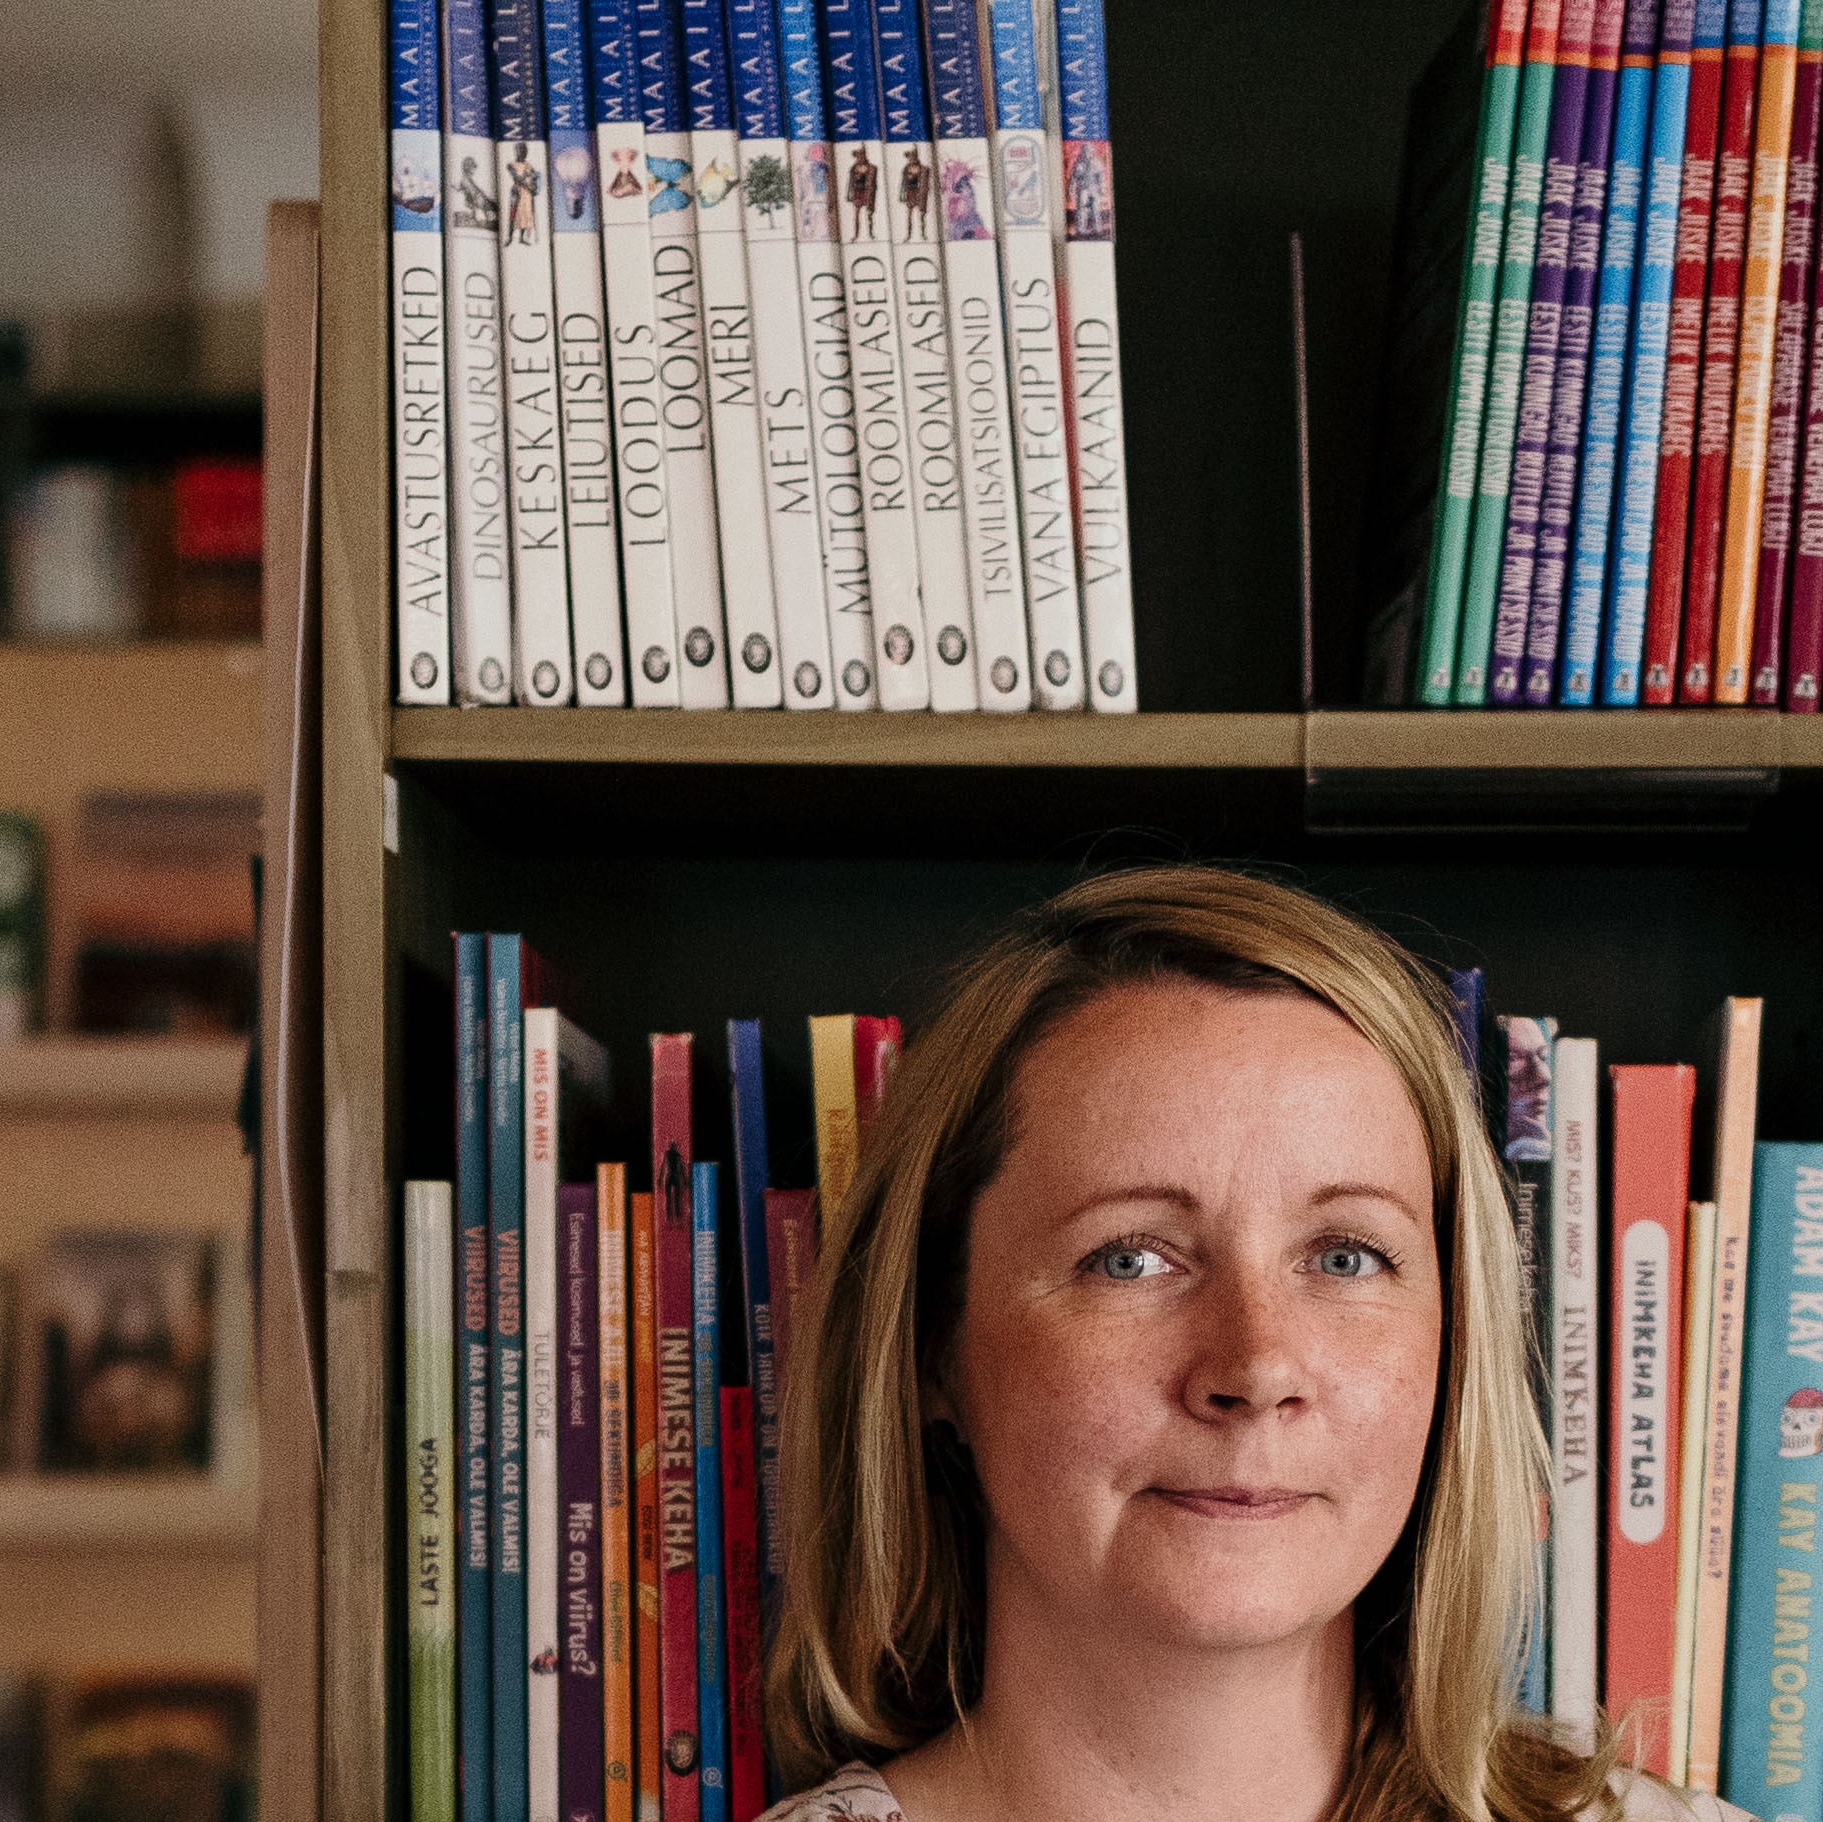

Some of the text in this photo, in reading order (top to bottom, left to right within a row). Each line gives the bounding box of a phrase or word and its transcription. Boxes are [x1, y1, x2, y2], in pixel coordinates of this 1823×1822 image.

[400, 266, 443, 618] AVASTUSRETKED
[464, 272, 503, 581] DINOSAURUSED
[509, 311, 559, 551] KESKAEG
[561, 312, 612, 529] LEIUTISED
[616, 324, 667, 546] LOODUS
[654, 244, 706, 454] LOOMAD
[709, 304, 754, 407] MERI
[766, 387, 812, 515] METS
[809, 272, 872, 618] MÜTOLOOGIAD
[849, 254, 906, 512] ROOMLASED
[903, 255, 959, 512] ROOMLASED
[961, 296, 1010, 600] TSIVILISATSIOONID
[1012, 278, 1069, 602] VANA EGIPTUS
[1074, 318, 1120, 586] VULKAANID
[533, 1048, 549, 1161] MIS ON MIS
[497, 1228, 521, 1336] VIIRUSED
[500, 1347, 523, 1384] ÄRA
[1561, 1121, 1587, 1488] MIS? KUS? MIKS? INIMKEHA
[418, 1437, 438, 1607] LASTE JOOGA
[501, 1462, 519, 1497] OLE
[501, 1501, 521, 1574] VALMIS!
[659, 1326, 693, 1571] INIMESE KEHA
[564, 1502, 599, 1677] Mis on viirus?
[1765, 1481, 1818, 1787] KAY ANATOOMIA
